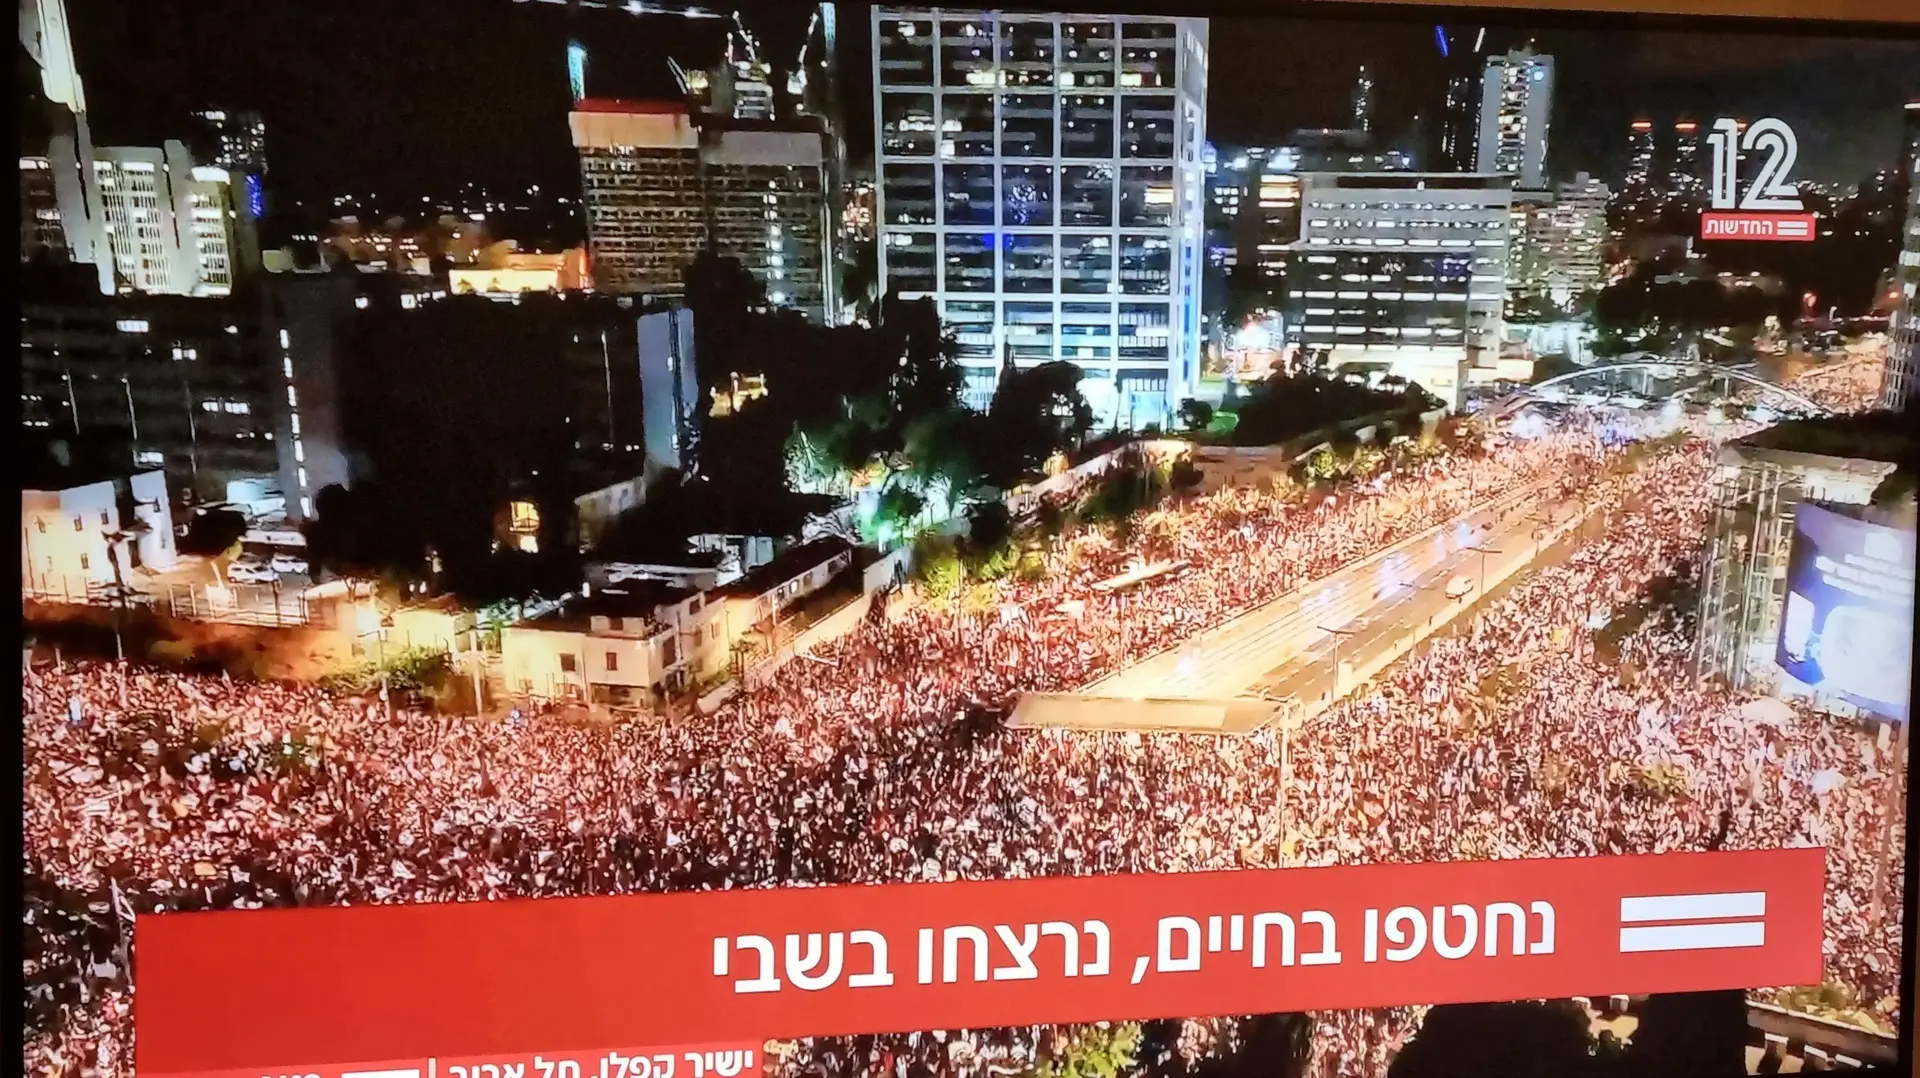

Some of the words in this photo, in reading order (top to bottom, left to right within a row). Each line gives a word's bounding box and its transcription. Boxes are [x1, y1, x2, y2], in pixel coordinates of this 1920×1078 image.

[1706, 117, 1804, 210] 12
[1705, 219, 1773, 235] החדשות
[713, 929, 894, 993] בשבי
[917, 919, 1111, 984] נרצחו
[1130, 910, 1342, 985] בחיים,
[1363, 900, 1556, 963] נחטפו
[591, 1052, 675, 1078] קפלן
[685, 1050, 754, 1078] ישיר
